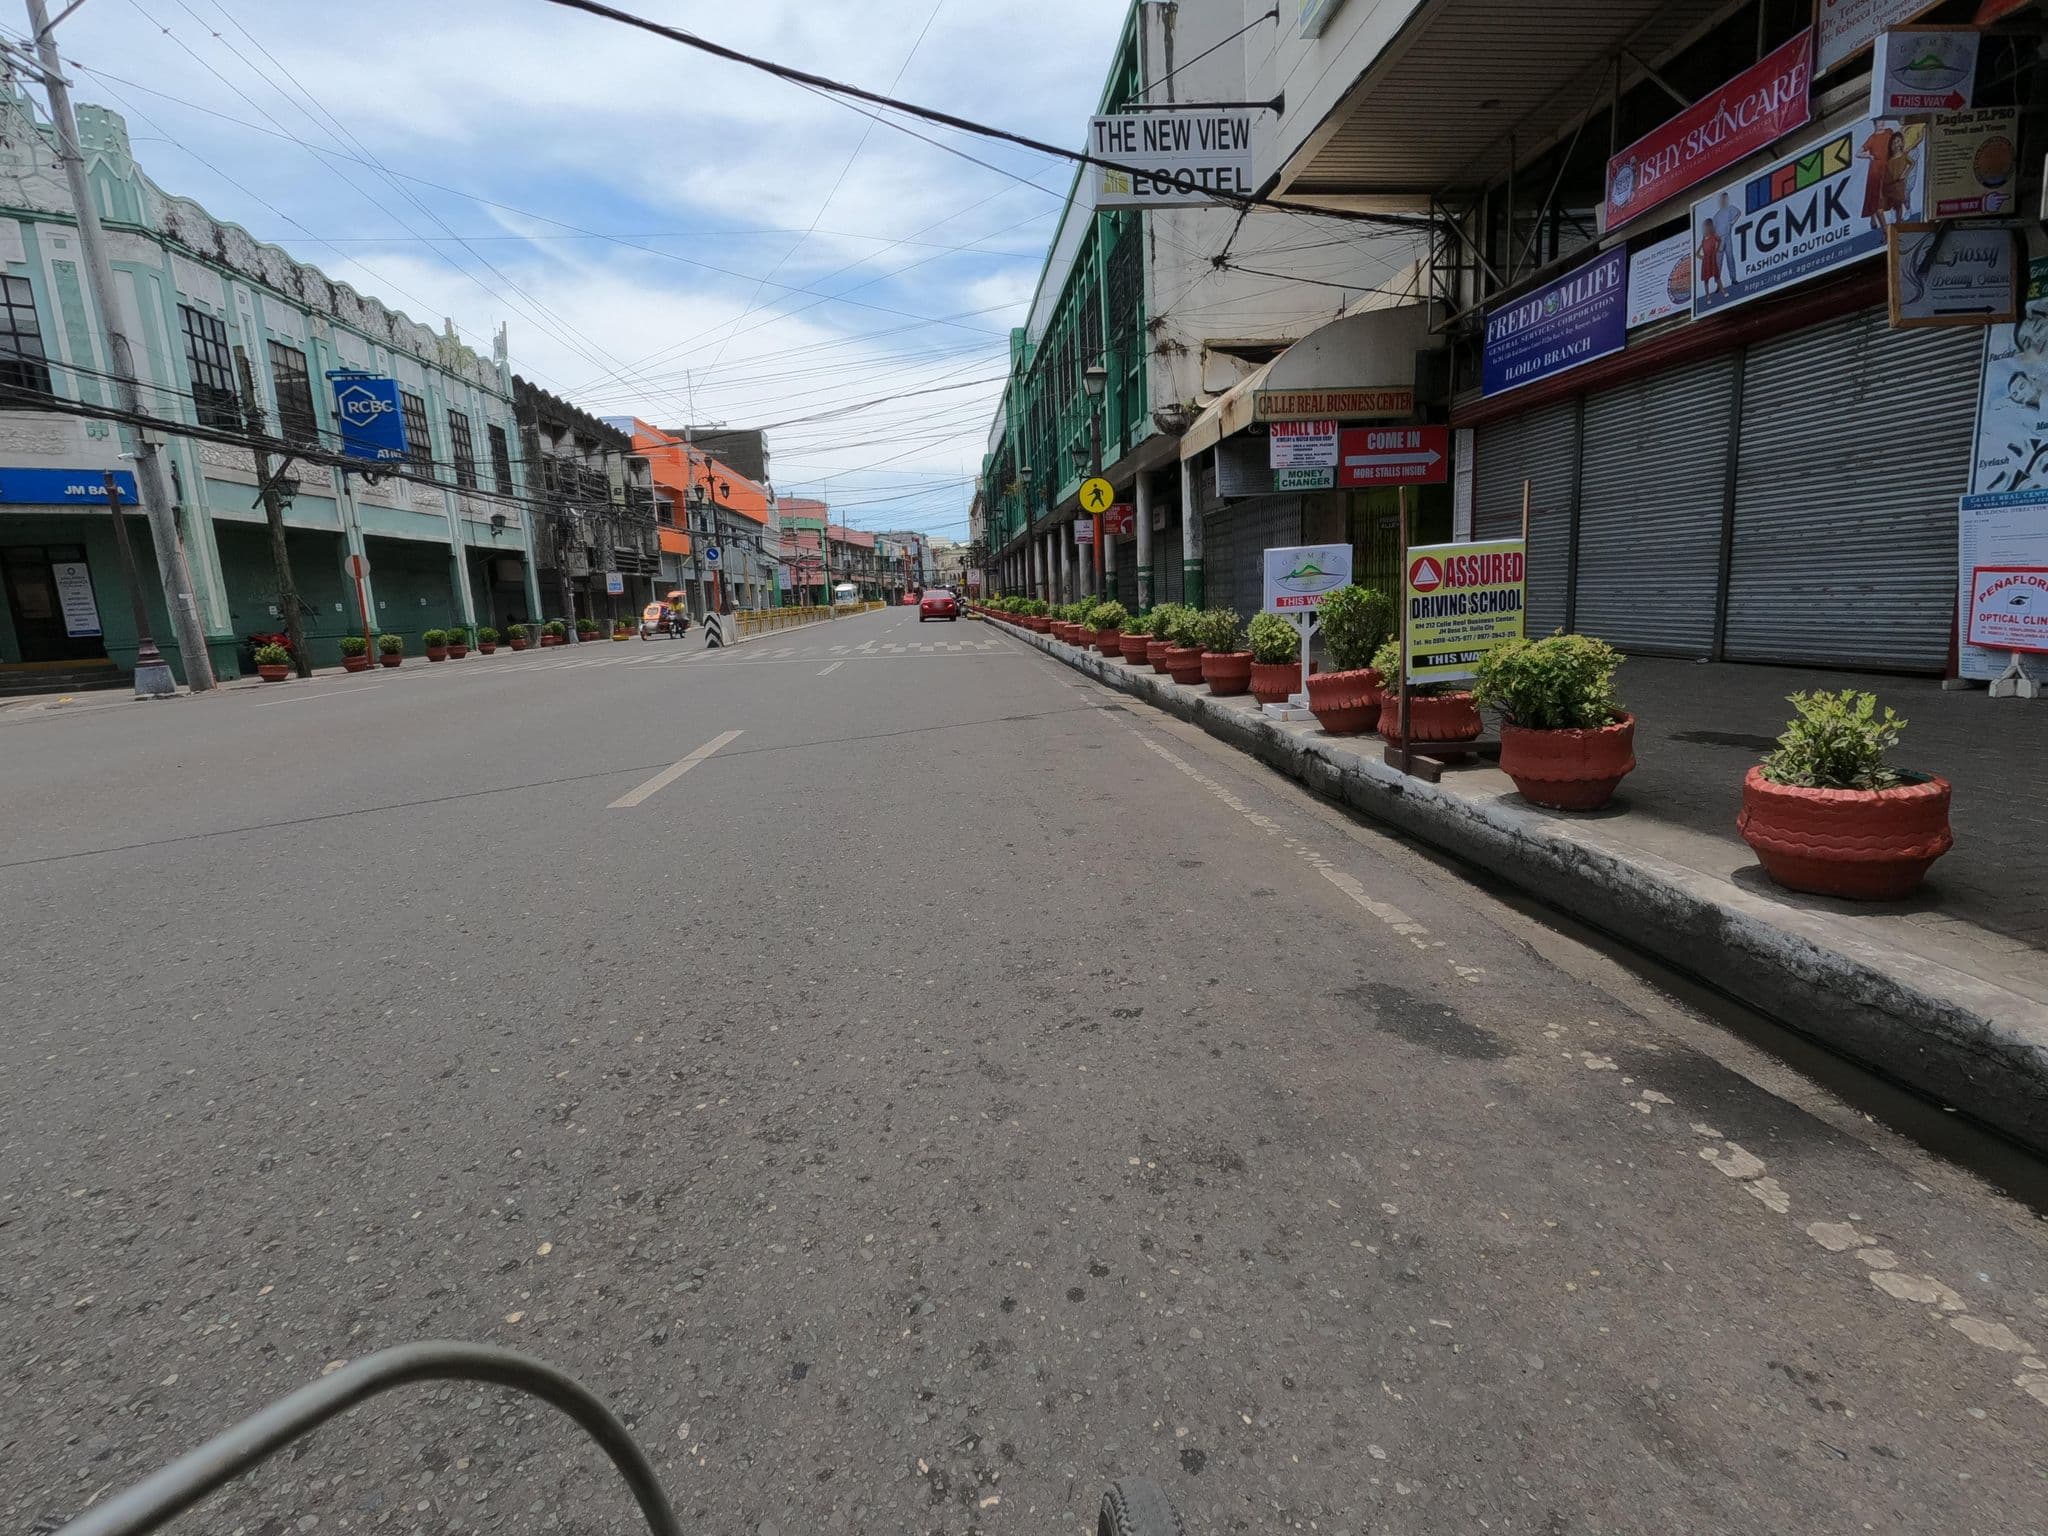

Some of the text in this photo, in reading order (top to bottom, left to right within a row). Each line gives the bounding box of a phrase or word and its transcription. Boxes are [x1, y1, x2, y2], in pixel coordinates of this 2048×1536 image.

[1897, 96, 1947, 107] THIS WAY
[1638, 136, 1686, 189] ISHY
[1685, 64, 1805, 160] SKINCARE
[1936, 113, 1974, 126] Eagles
[1094, 118, 1250, 152] THE NEW VIEW
[1970, 125, 1984, 133] and
[1133, 167, 1252, 195] ECOTEL
[1734, 175, 1852, 262] TGMK
[1746, 224, 1851, 275] FASHION BOUTIQUE
[1488, 338, 1519, 356] GENERAL
[1521, 324, 1555, 342] SERVICES
[1557, 296, 1615, 327] CORPORATION
[1505, 358, 1541, 380] ILOILO
[1544, 337, 1591, 366] BRANCH
[348, 400, 394, 414] RCBC
[1259, 391, 1412, 415] CALLE REAL BUSINESS CENTER
[1272, 420, 1336, 437] SMALL BOY
[1367, 431, 1421, 450] COME IN
[1979, 457, 2010, 471] Eyelash
[1288, 469, 1324, 478] MONEY
[1353, 465, 1427, 479] MORE STALLS INSIDE
[1281, 477, 1330, 487] CHANGER
[64, 486, 126, 496] JM BAA
[2023, 489, 2048, 498] CENT
[1444, 552, 1523, 588] ASSURED
[1283, 597, 1305, 606] THIS
[1411, 589, 1522, 619] DRIVING SCHOOL
[1979, 613, 2019, 624] OPTICAL
[1427, 651, 1482, 665] THIS WA
